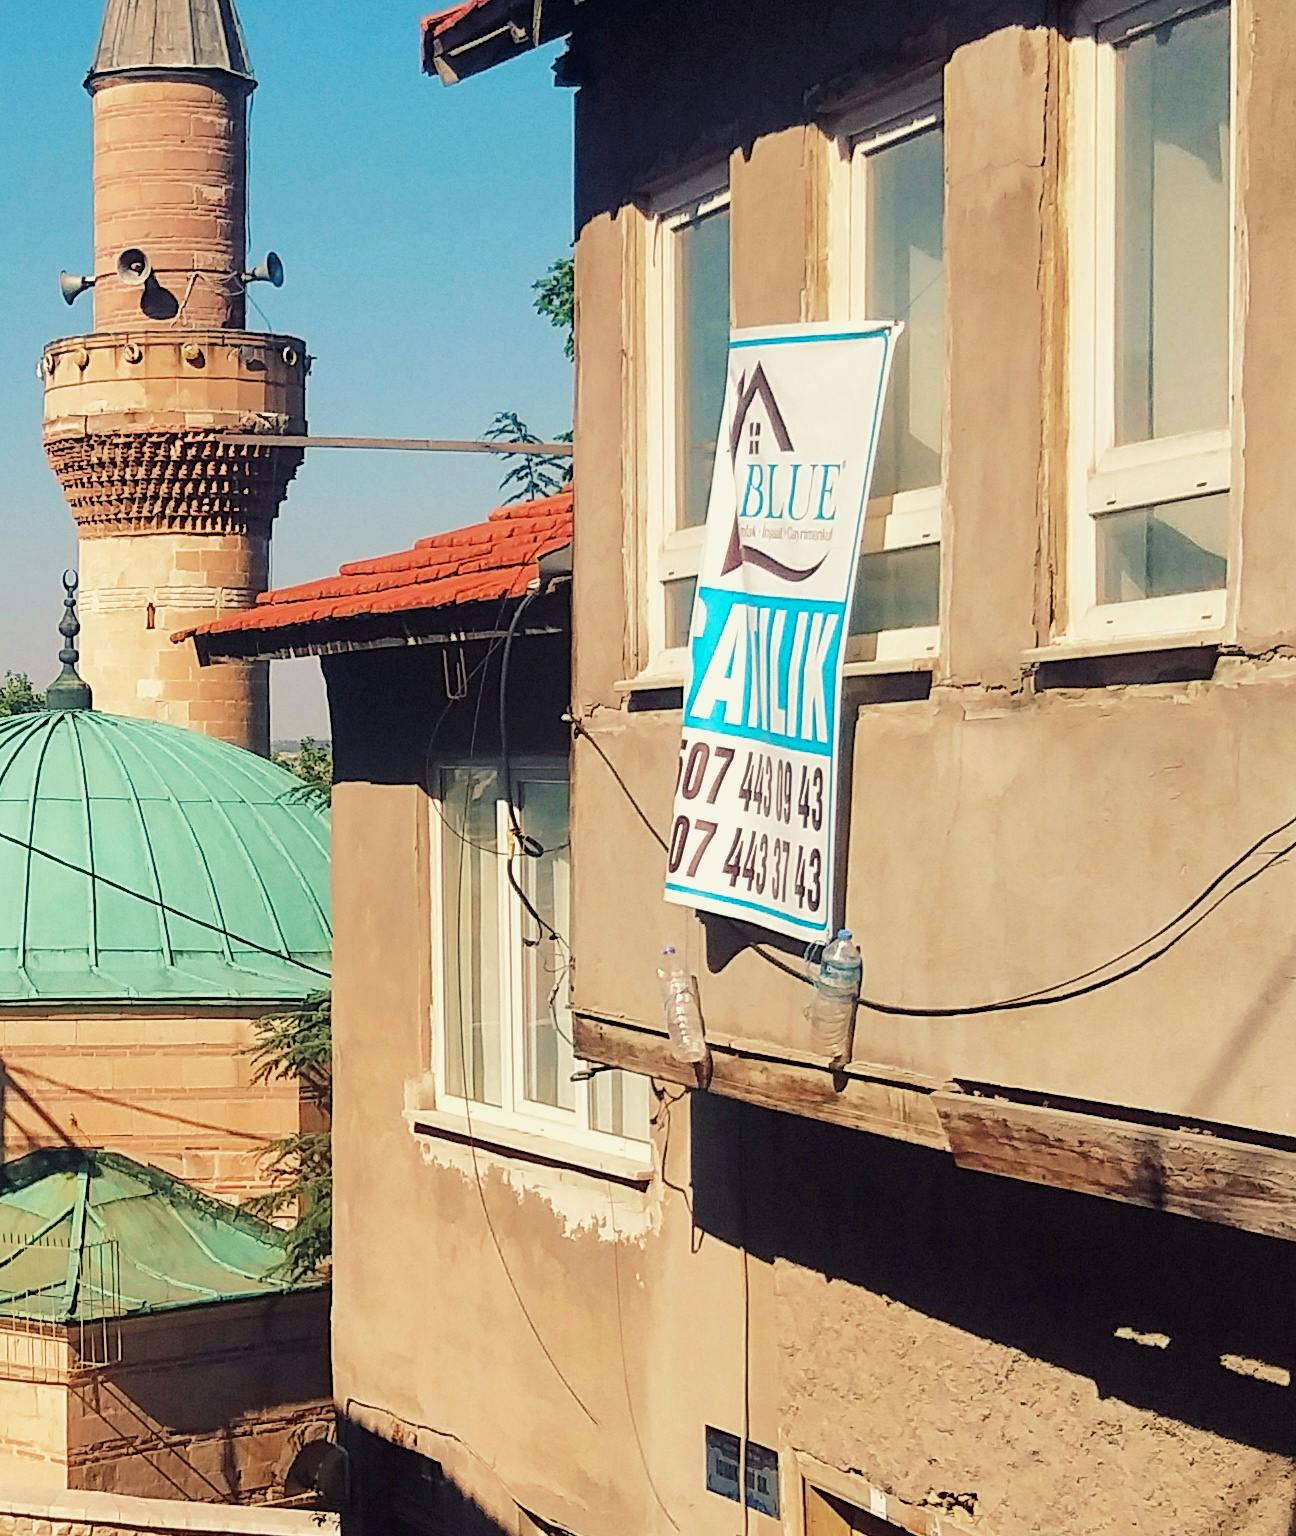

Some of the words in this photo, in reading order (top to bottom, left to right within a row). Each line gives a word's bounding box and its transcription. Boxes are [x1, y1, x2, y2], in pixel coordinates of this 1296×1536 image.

[739, 463, 841, 521] BLUE
[738, 751, 773, 818] 443
[775, 759, 793, 824] 09
[797, 764, 824, 832] 43
[722, 827, 769, 895] 443
[771, 837, 791, 903] 37
[794, 844, 822, 912] 43
